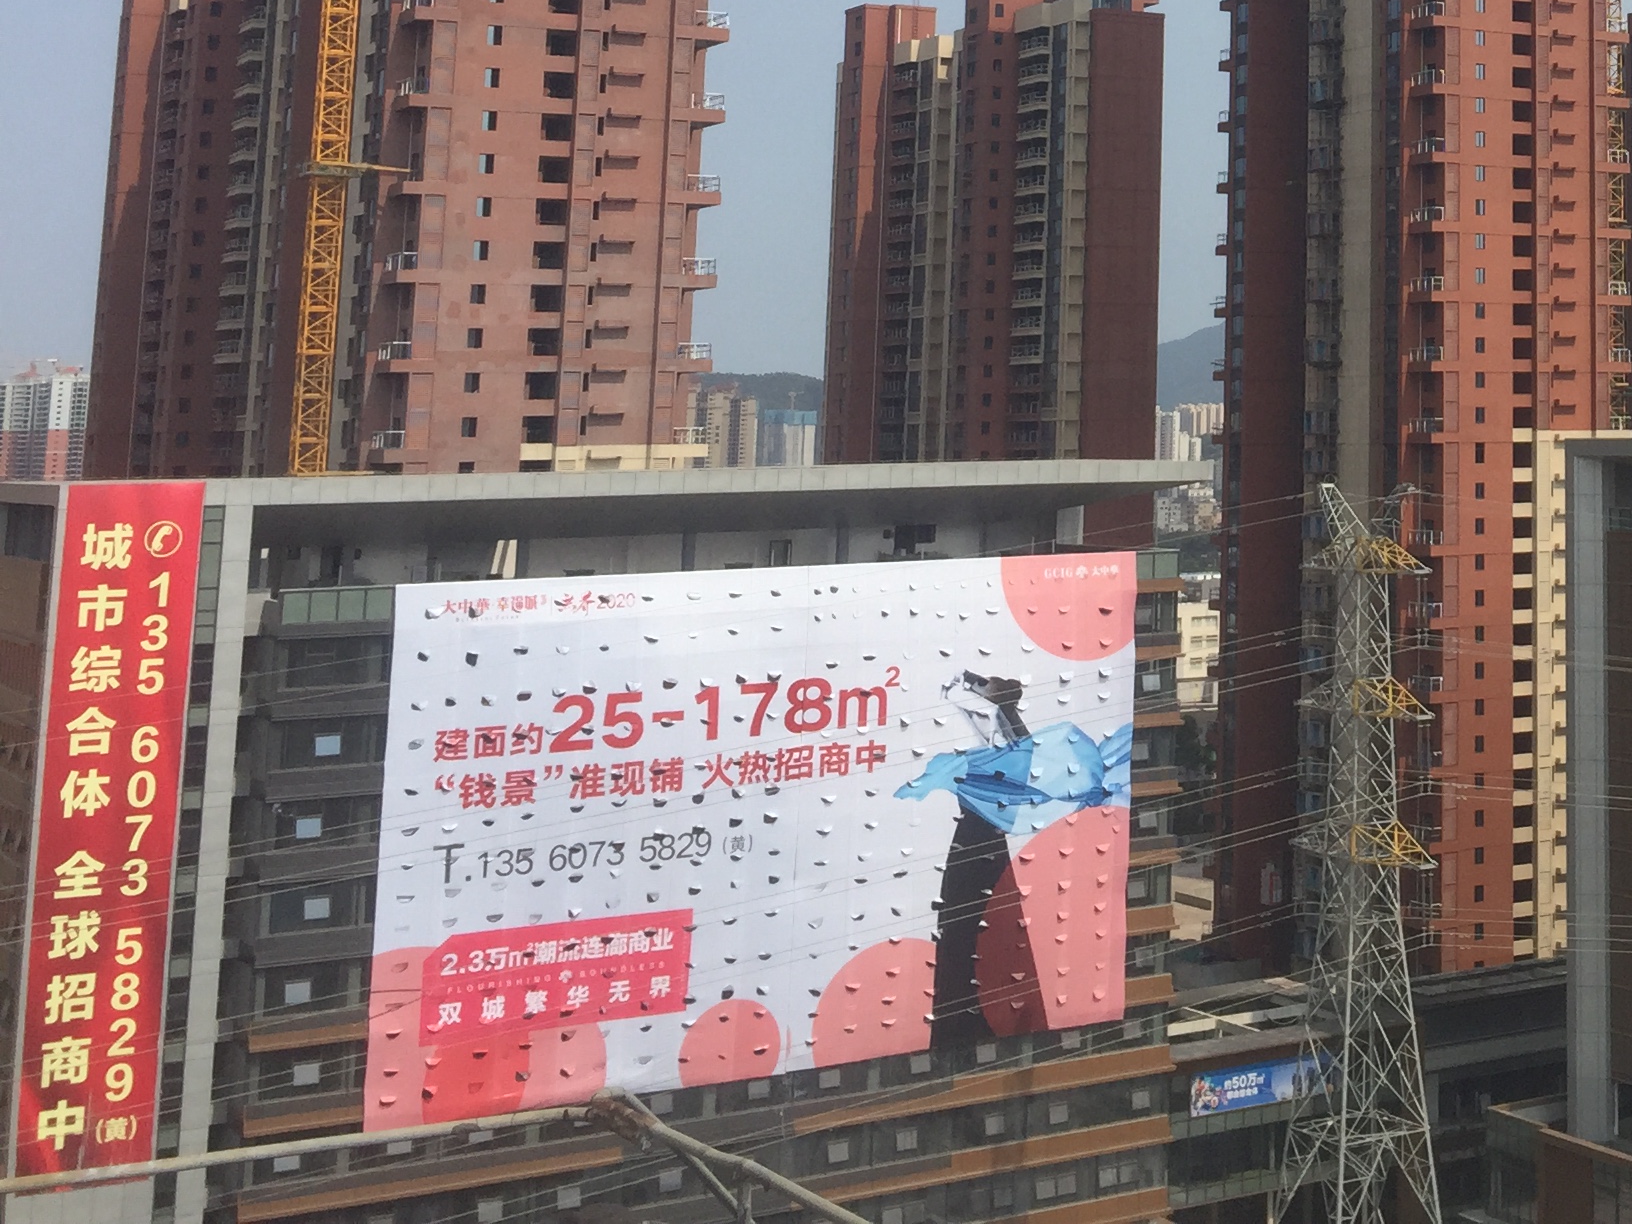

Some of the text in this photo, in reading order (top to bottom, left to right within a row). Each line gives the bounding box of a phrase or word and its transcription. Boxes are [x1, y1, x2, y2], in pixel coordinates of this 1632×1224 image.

[137, 572, 172, 696] 135
[36, 522, 134, 1152] 城市综合体 全球招商中
[119, 725, 161, 897] 6073
[702, 740, 887, 790] 火热招商中
[548, 841, 625, 872] 6073
[638, 830, 713, 864] 5829
[104, 927, 145, 1104] 5829
